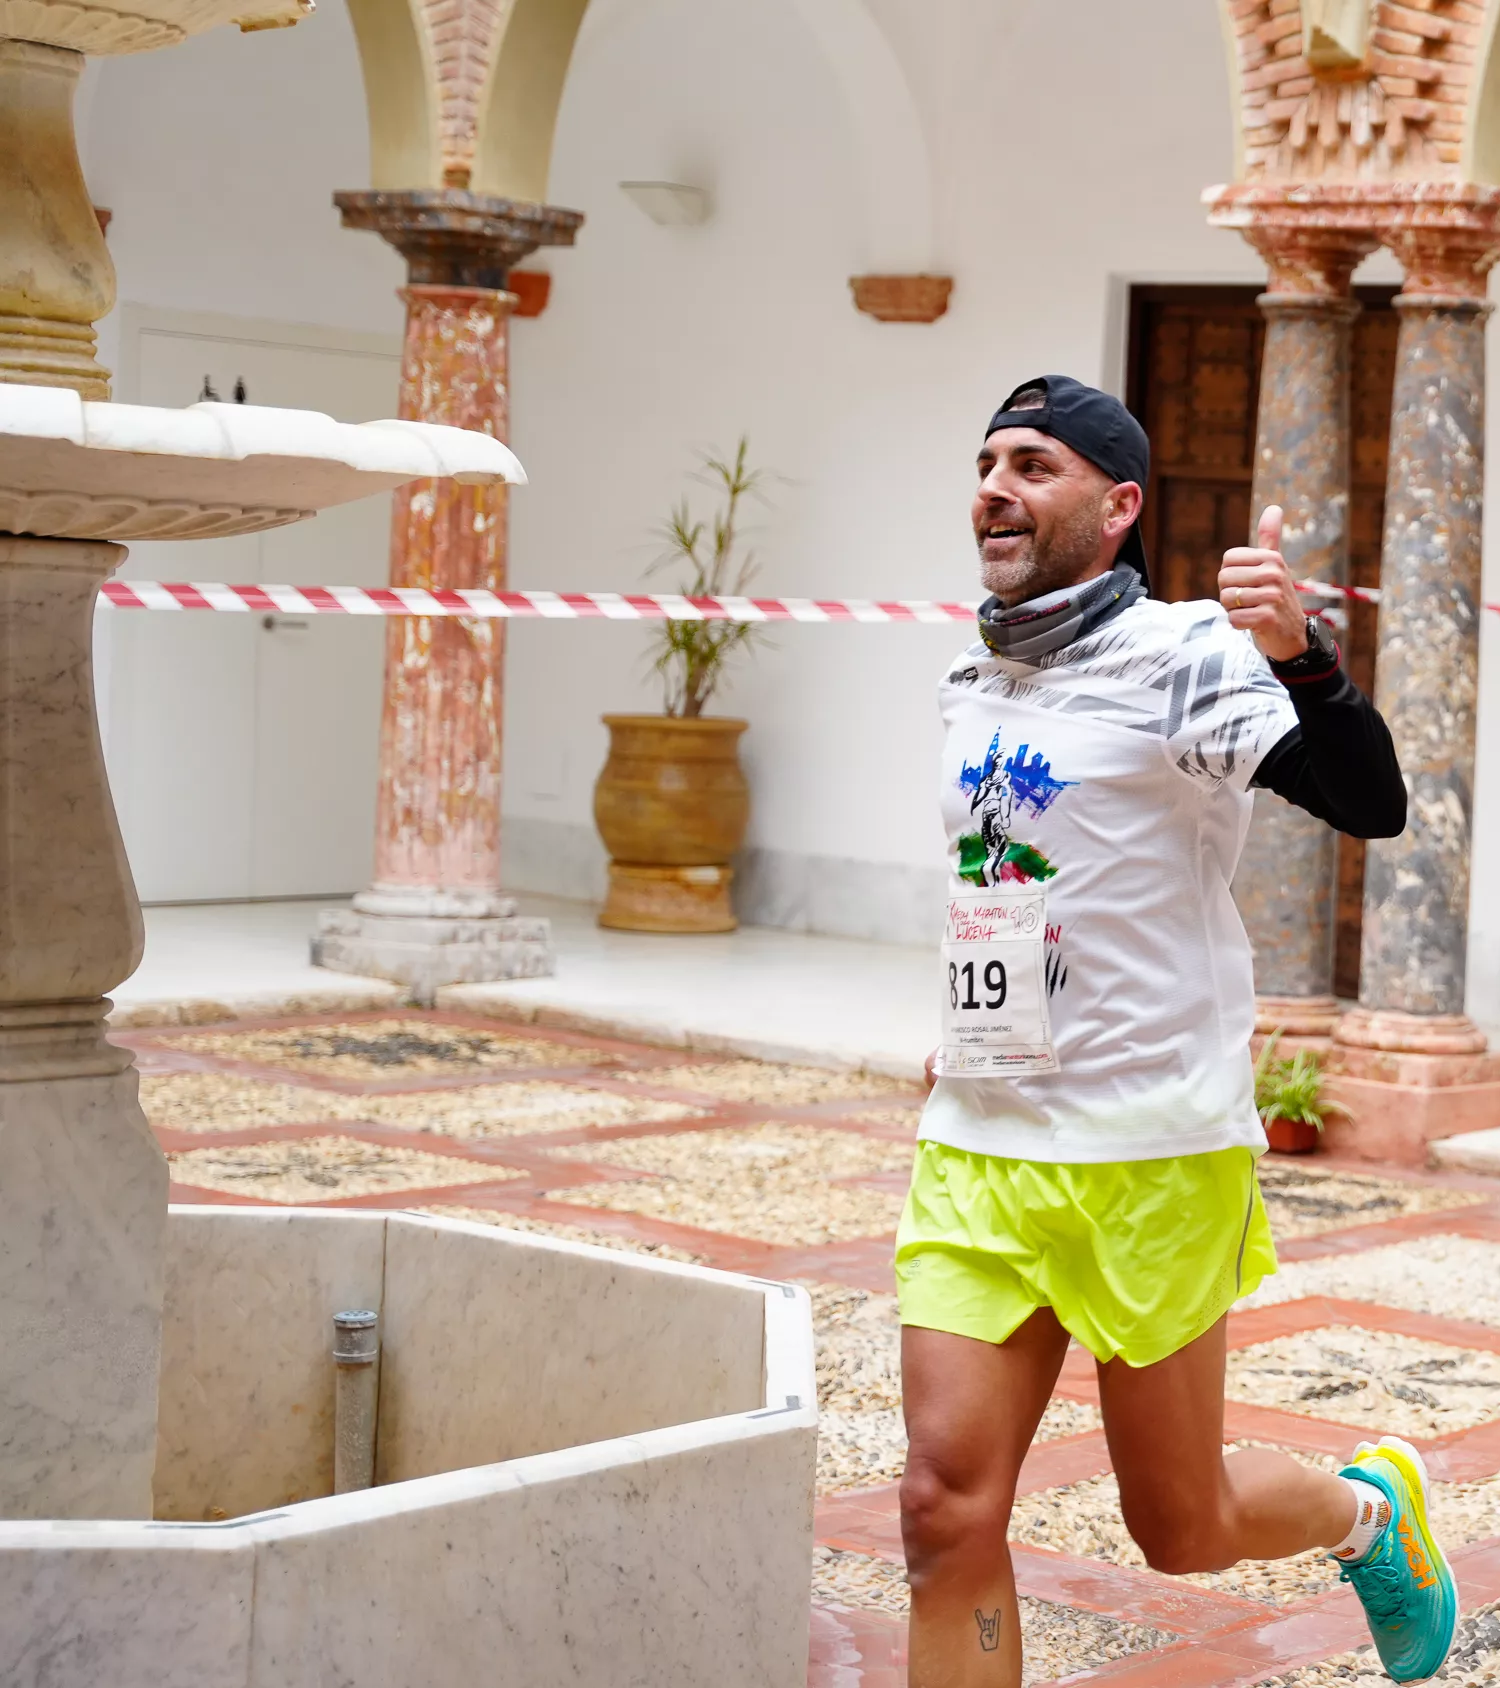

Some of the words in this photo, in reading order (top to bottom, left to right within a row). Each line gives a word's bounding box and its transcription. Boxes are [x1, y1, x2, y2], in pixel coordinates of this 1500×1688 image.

[956, 923, 997, 941] LUCENA
[949, 960, 1007, 1010] 819
[1397, 1513, 1437, 1590] HOKA
